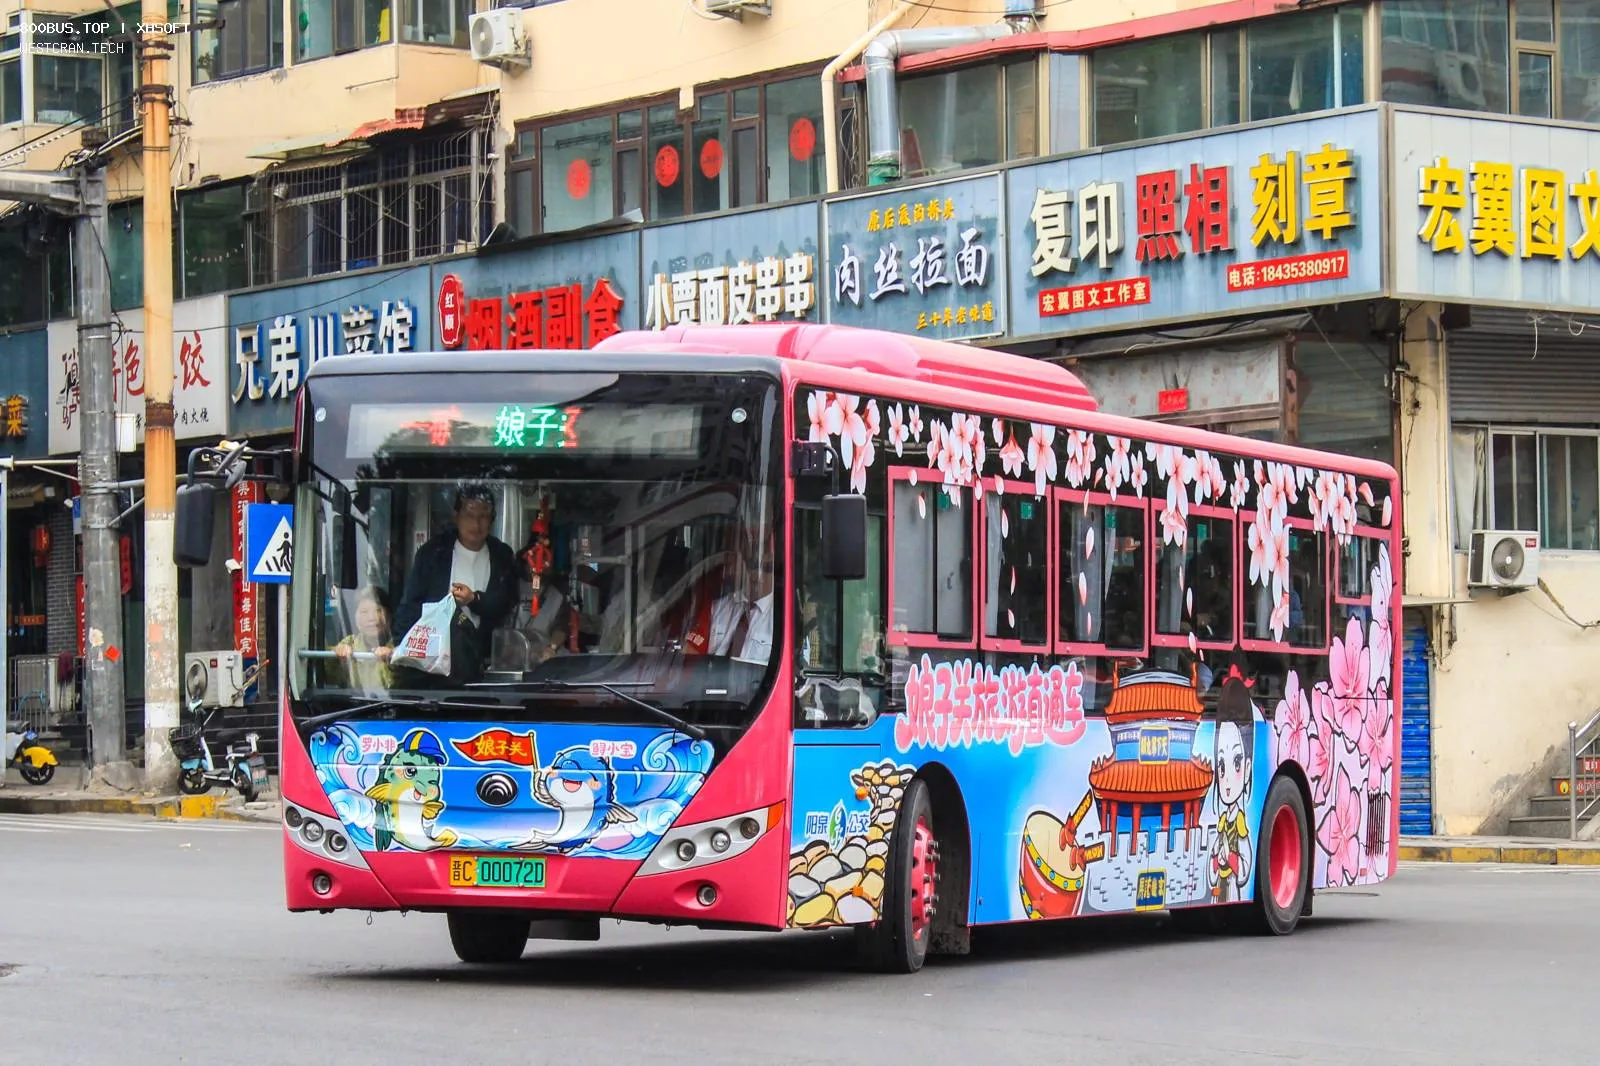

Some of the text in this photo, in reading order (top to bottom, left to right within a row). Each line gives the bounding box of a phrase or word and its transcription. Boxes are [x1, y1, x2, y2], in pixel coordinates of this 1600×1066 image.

[1031, 142, 1356, 277] 复印 照相 刻章
[1418, 156, 1600, 261] 宏翼图文
[646, 252, 814, 332] 小贾面皮串串
[834, 227, 988, 306] 肉丝拉面
[1042, 281, 1147, 313] 宏翼图文工作室
[232, 299, 415, 404] 兄弟川菜馆
[465, 276, 624, 350] 烟酒副食
[895, 653, 1087, 757] 娘子关旅游直通车
[473, 735, 528, 759] 娘子关
[806, 813, 870, 835] 阳泉 公交
